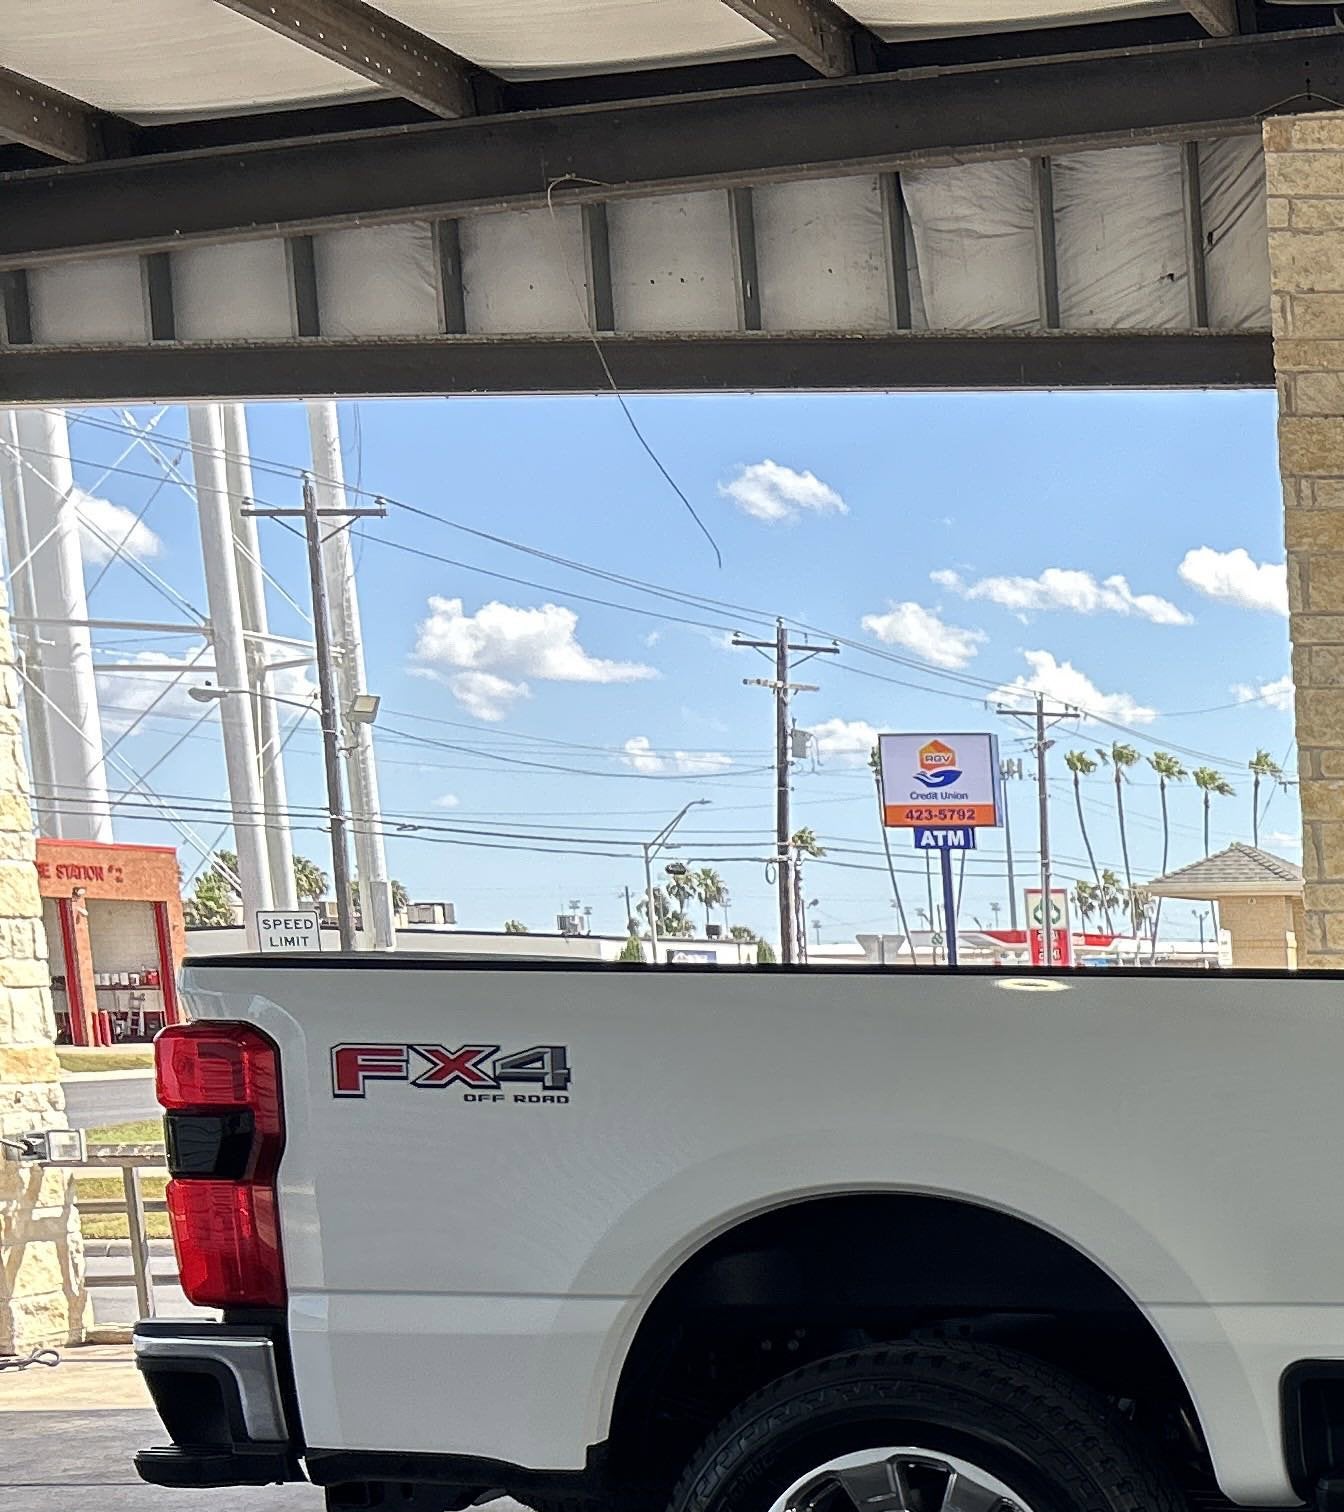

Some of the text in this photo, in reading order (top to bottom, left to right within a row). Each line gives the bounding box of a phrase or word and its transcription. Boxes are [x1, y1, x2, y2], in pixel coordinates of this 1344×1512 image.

[910, 791, 968, 800] Credit Union
[905, 808, 975, 821] 423-5792
[920, 830, 965, 847] ATM
[56, 864, 104, 881] STATION
[262, 919, 314, 930] SPEED
[270, 936, 309, 947] LIMIT
[331, 1043, 571, 1098] FX4
[463, 1093, 570, 1104] OFF ROAD
